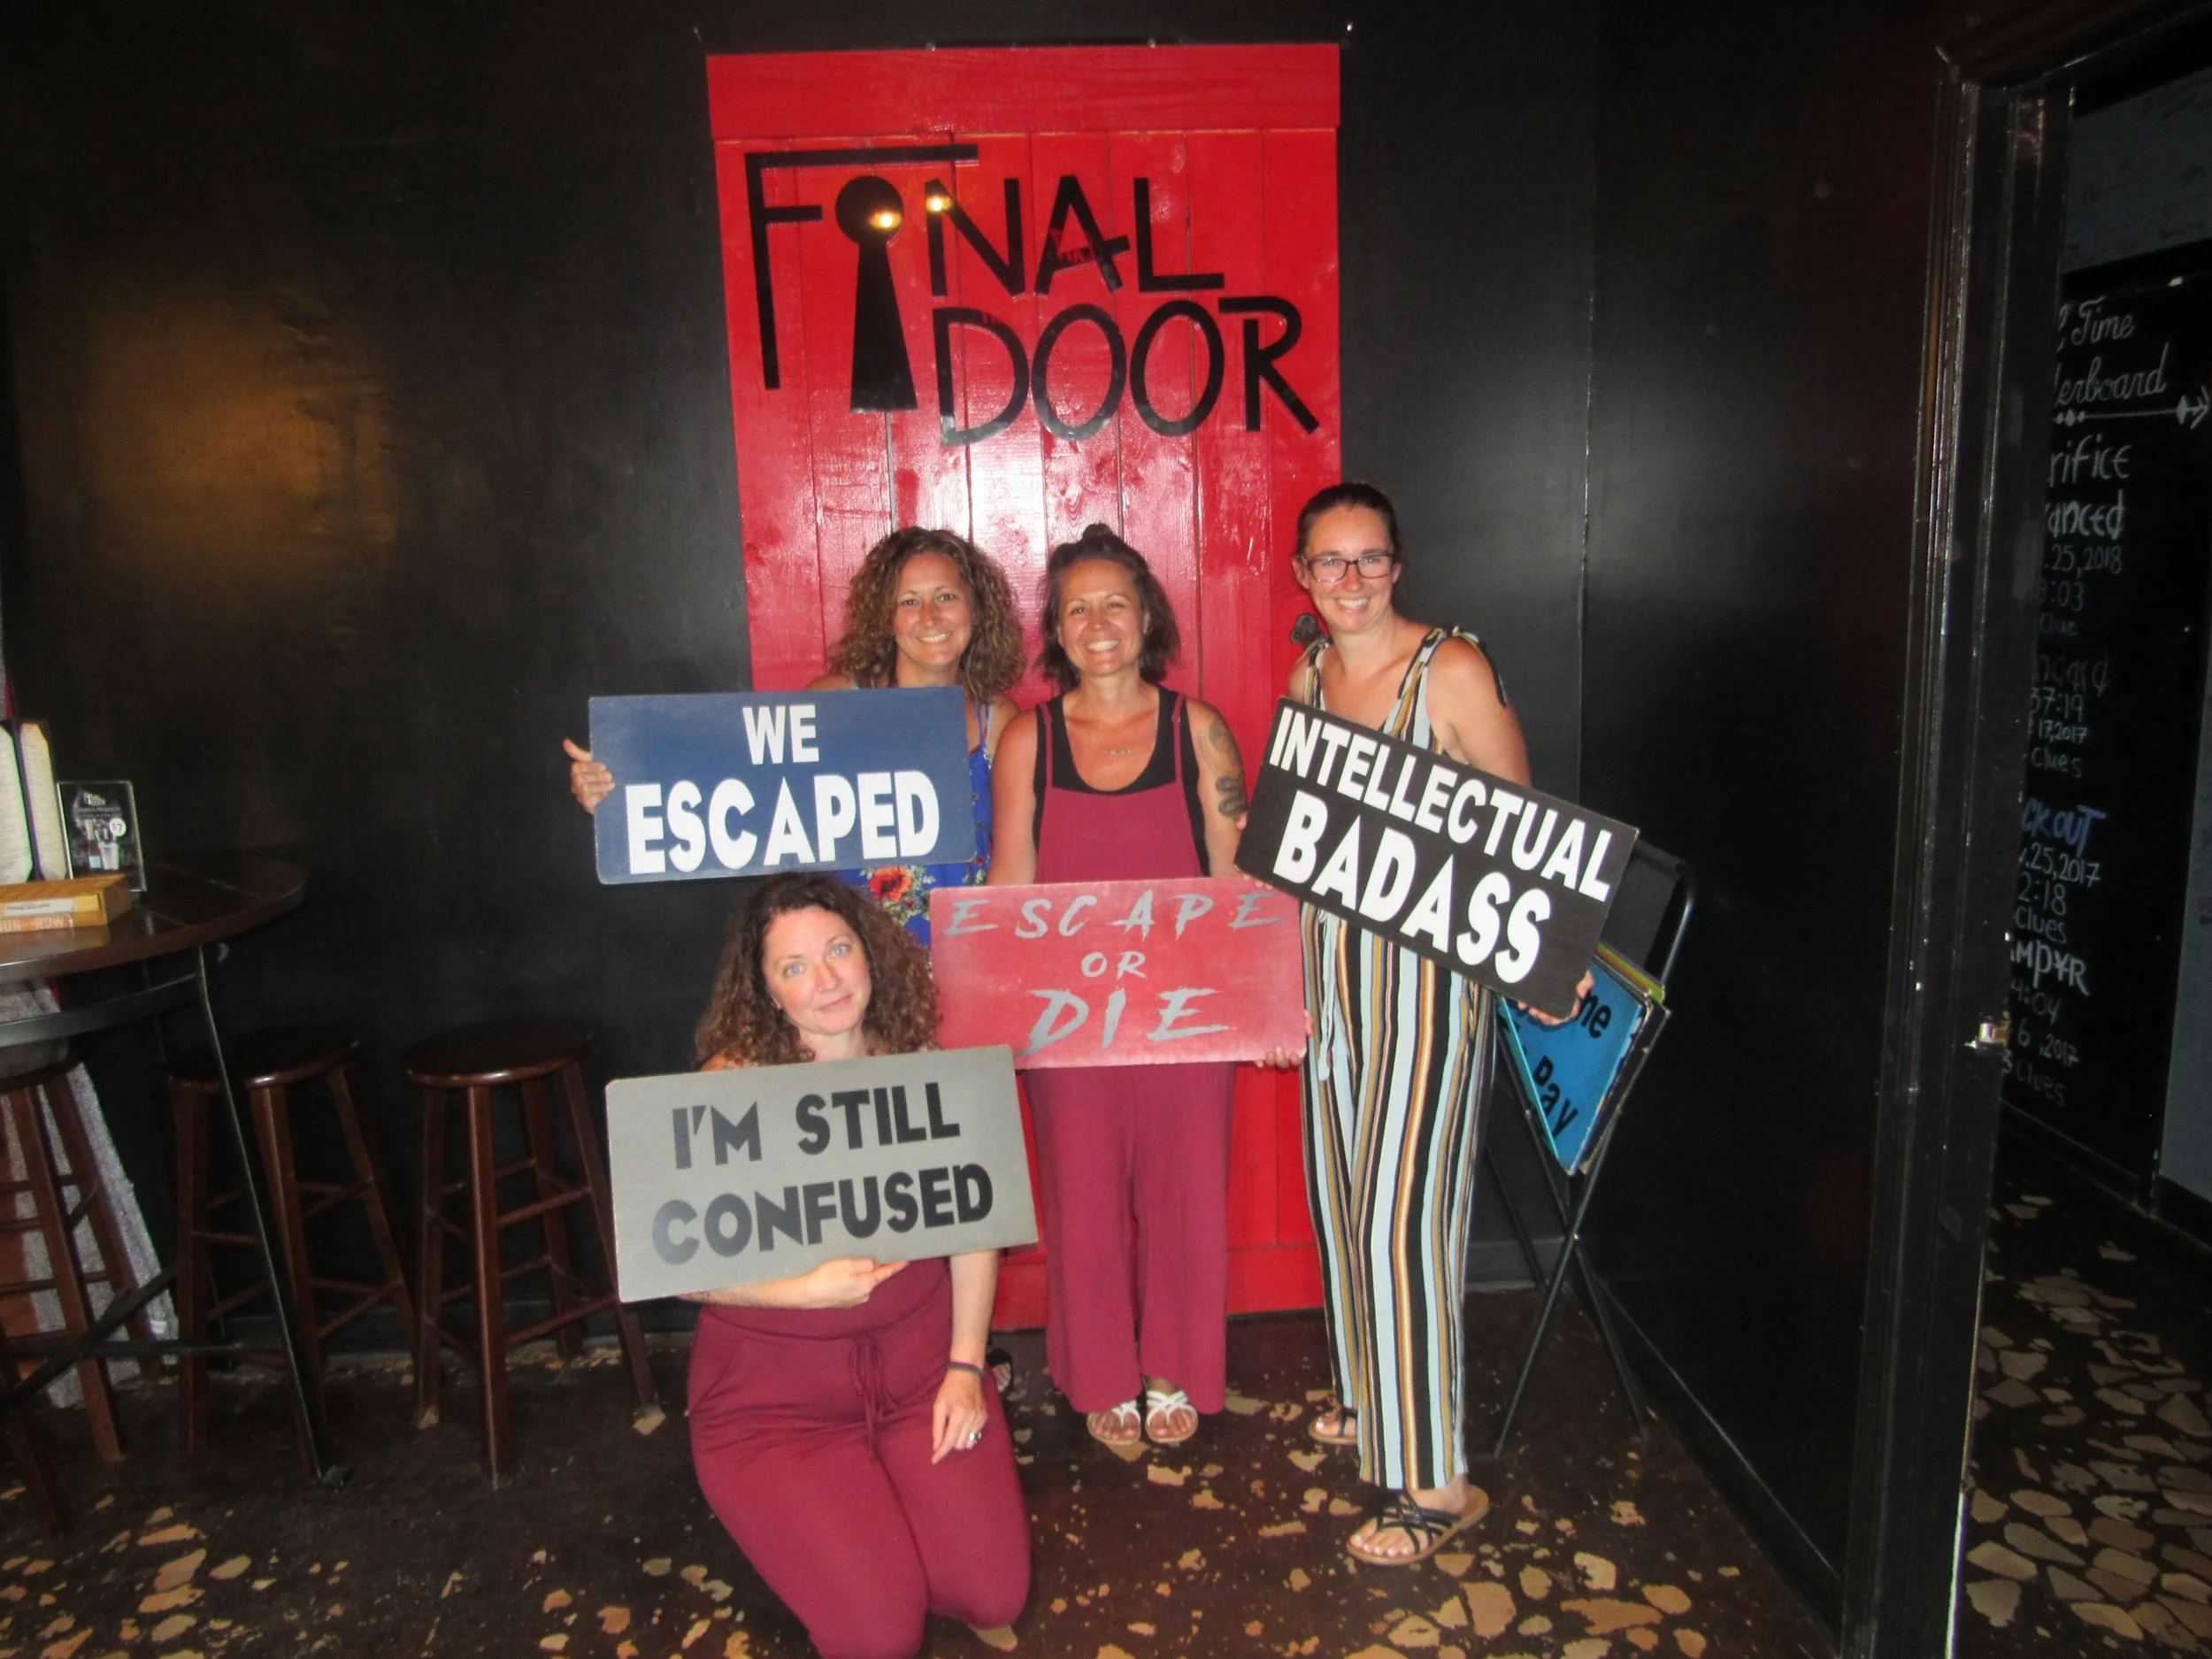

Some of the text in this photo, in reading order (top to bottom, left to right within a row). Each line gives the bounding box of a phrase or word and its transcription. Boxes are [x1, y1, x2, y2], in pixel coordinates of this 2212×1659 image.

[2071, 295, 2137, 346] Time
[932, 296, 1319, 446] DOOR
[2054, 340, 2171, 408] erboard
[2045, 488, 2126, 541] anced
[741, 704, 820, 765] WE
[625, 770, 941, 876] ESCAPED
[1268, 705, 1614, 904] INTELLECTUAL
[942, 888, 1284, 941] ESCAPE
[1271, 789, 1552, 985] BADASS
[2015, 905, 2068, 945] Clues
[1080, 950, 1147, 979] OR
[1014, 986, 1239, 1059] DIE
[671, 1081, 961, 1171] I'M STILL
[650, 1163, 994, 1266] CONFUSED
